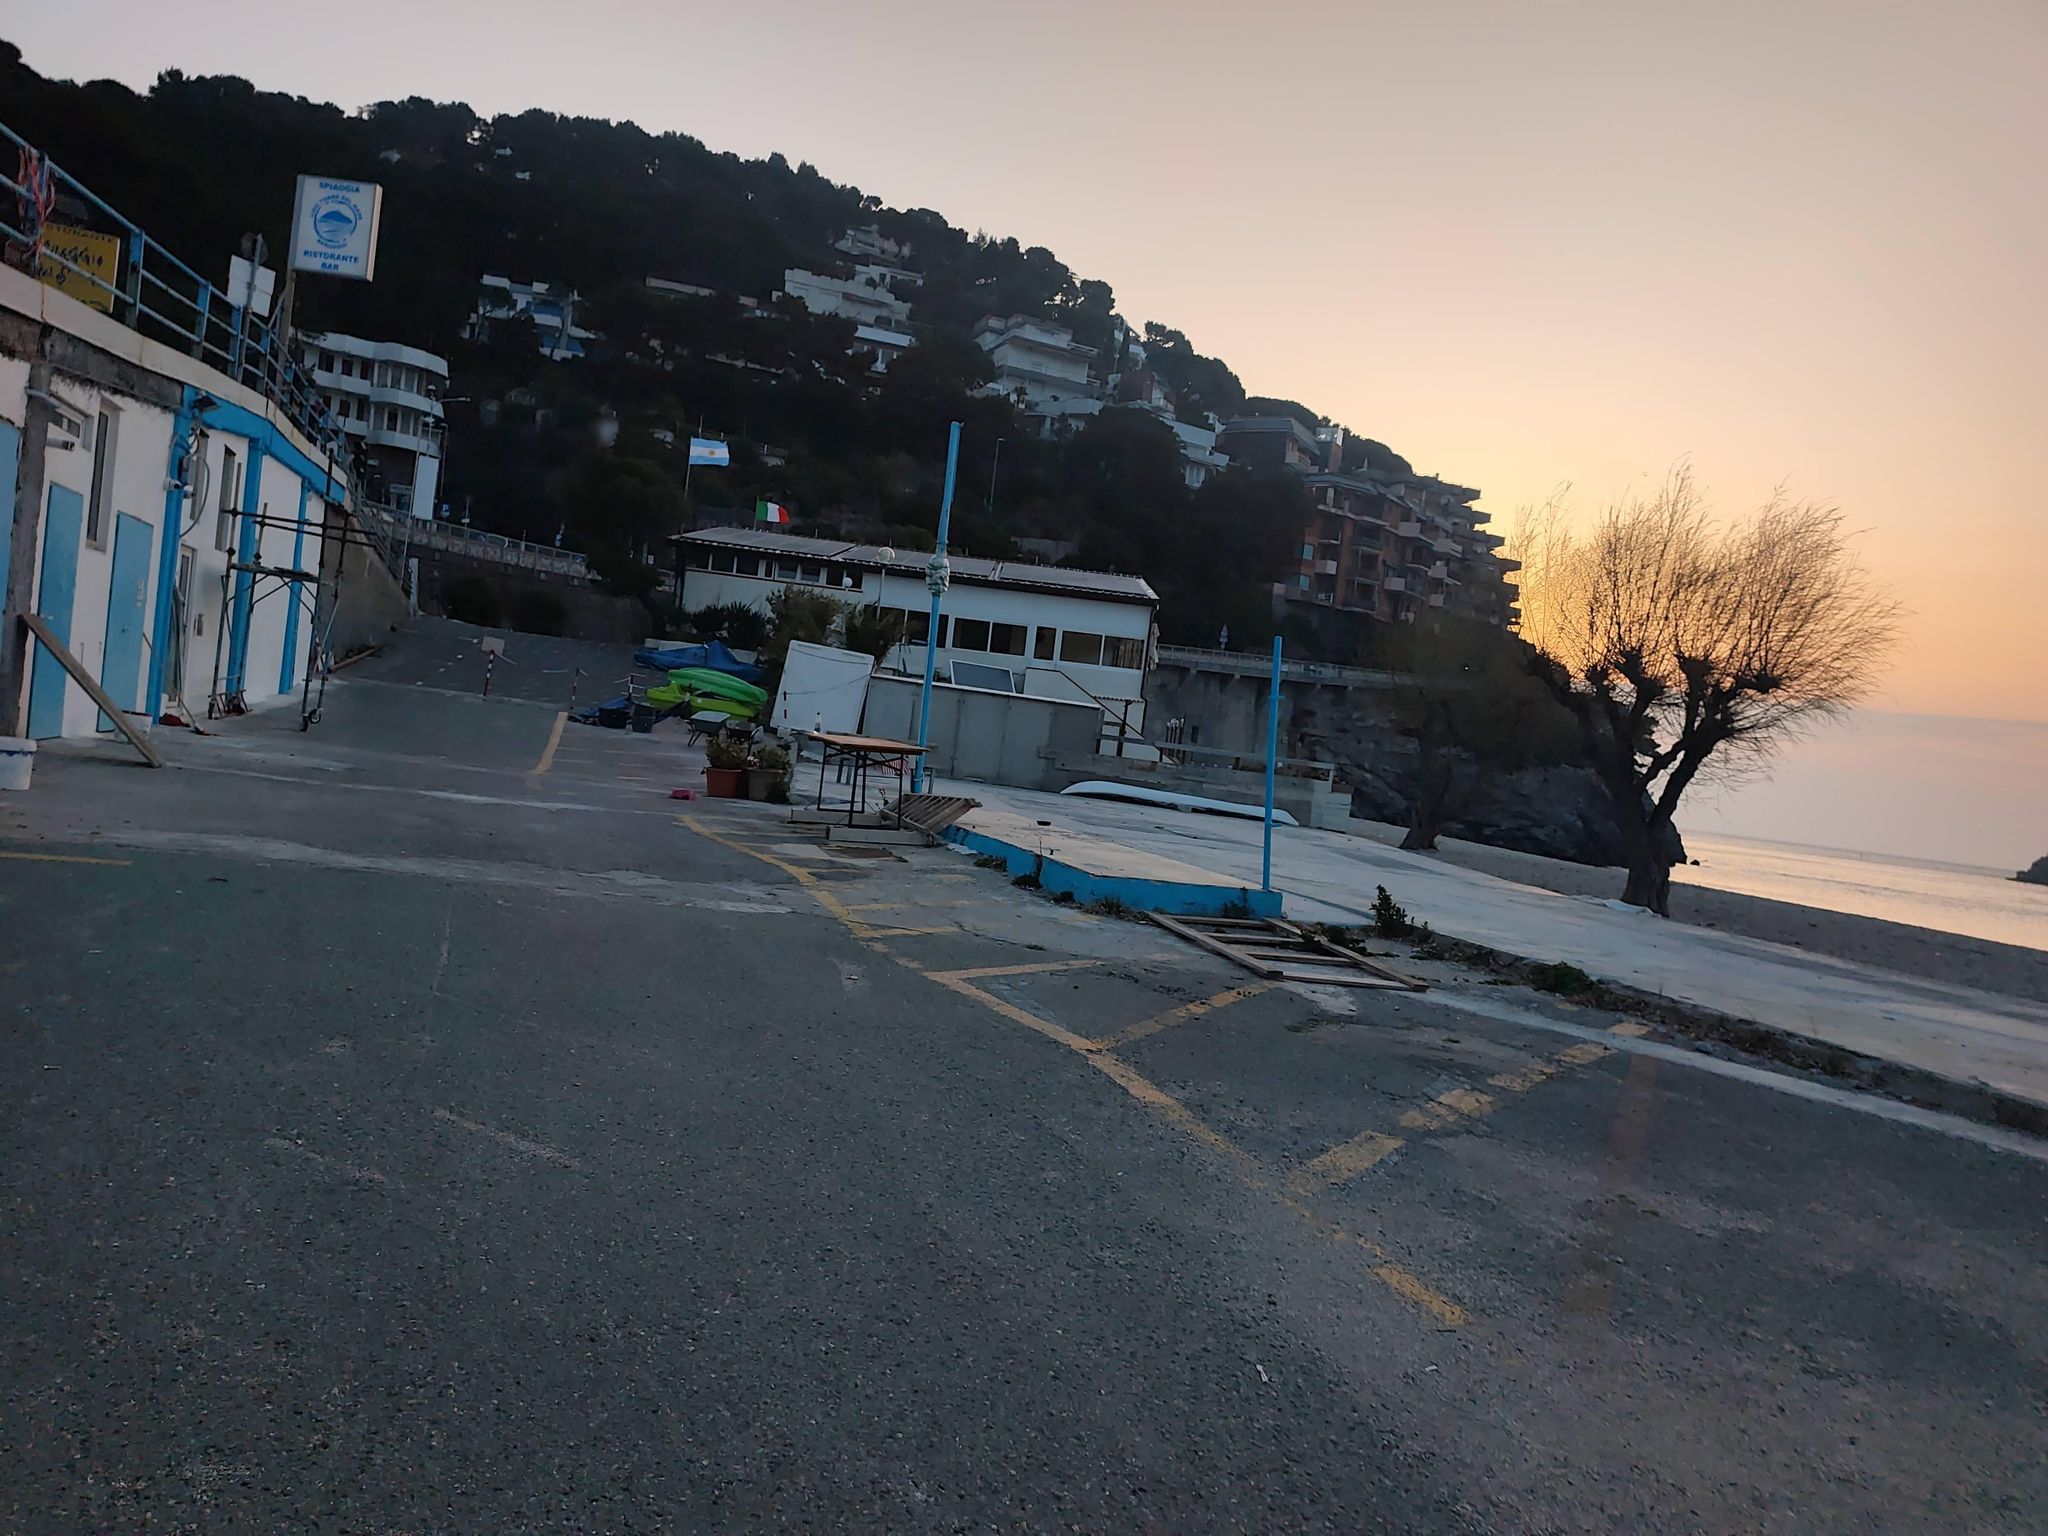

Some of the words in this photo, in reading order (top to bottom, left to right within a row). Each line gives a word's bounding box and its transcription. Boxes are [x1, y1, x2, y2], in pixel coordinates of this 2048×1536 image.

[319, 182, 360, 193] SPIAGGIA
[303, 250, 359, 264] RISTORANTE
[321, 262, 340, 271] BAR
